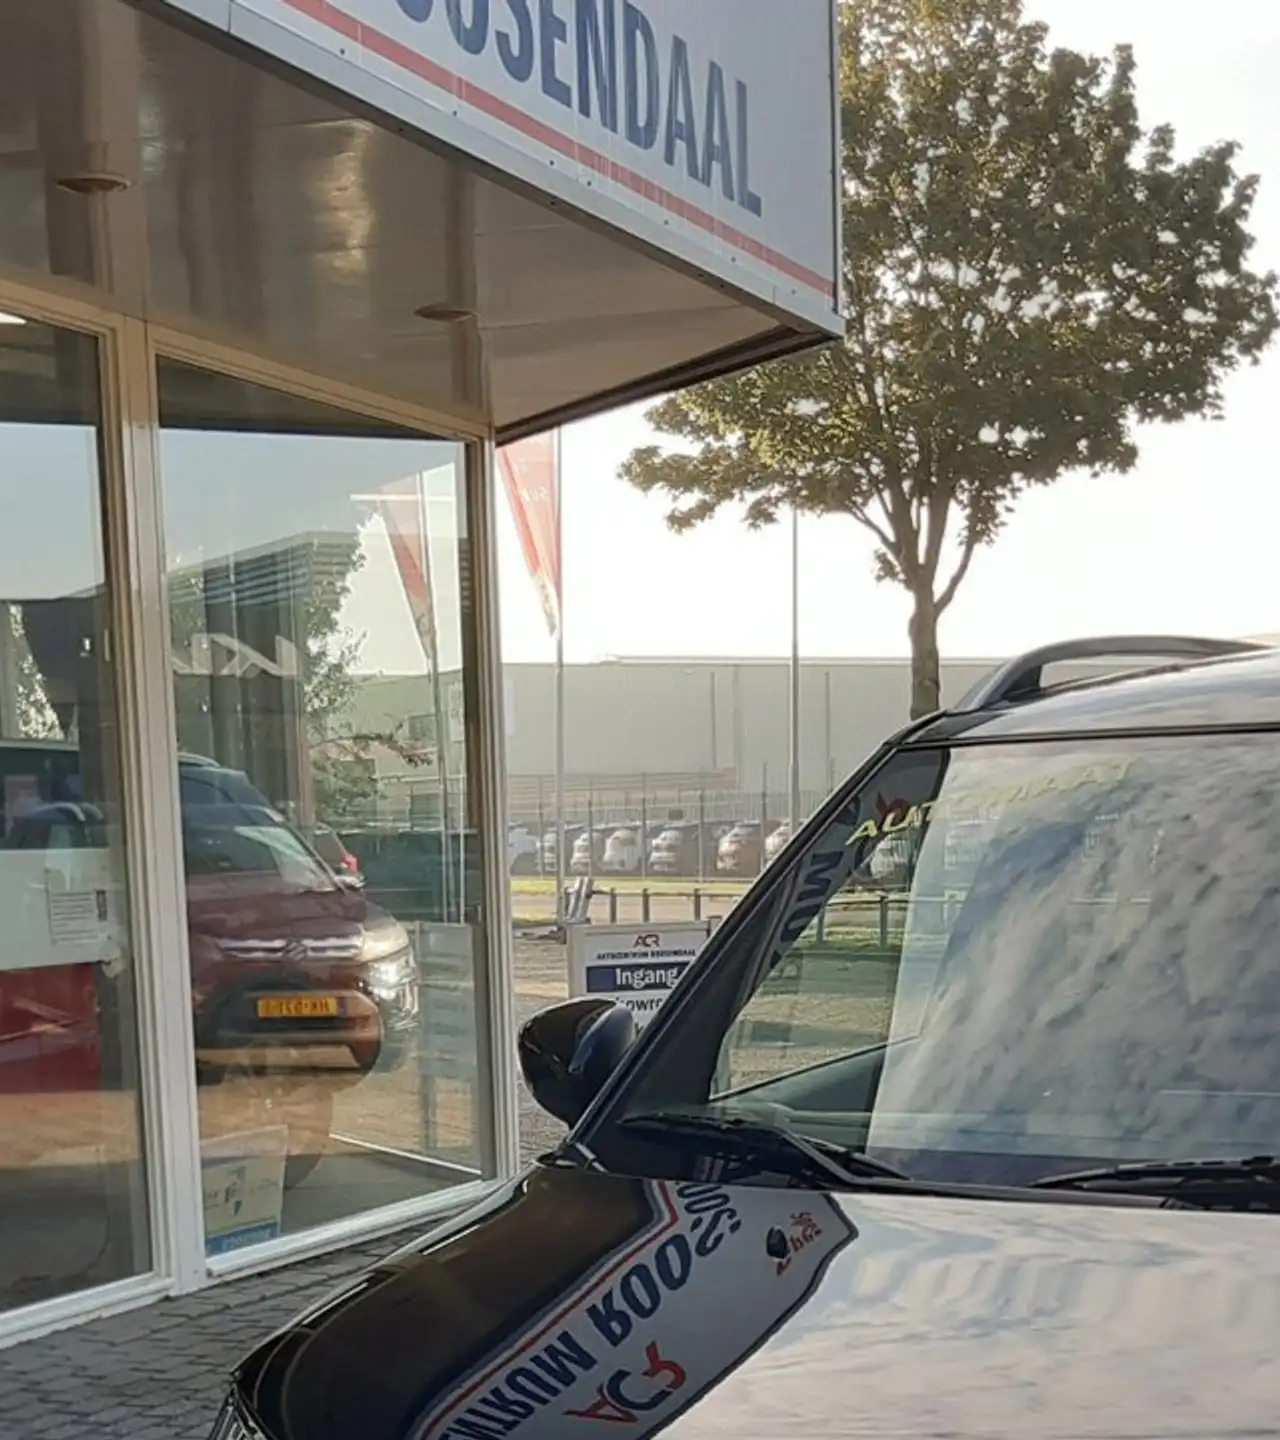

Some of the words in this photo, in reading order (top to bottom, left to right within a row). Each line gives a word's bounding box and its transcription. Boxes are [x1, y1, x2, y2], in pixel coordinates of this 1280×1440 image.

[395, 0, 761, 217] SENDAAL
[633, 933, 661, 949] ACR
[615, 966, 679, 989] Ingang
